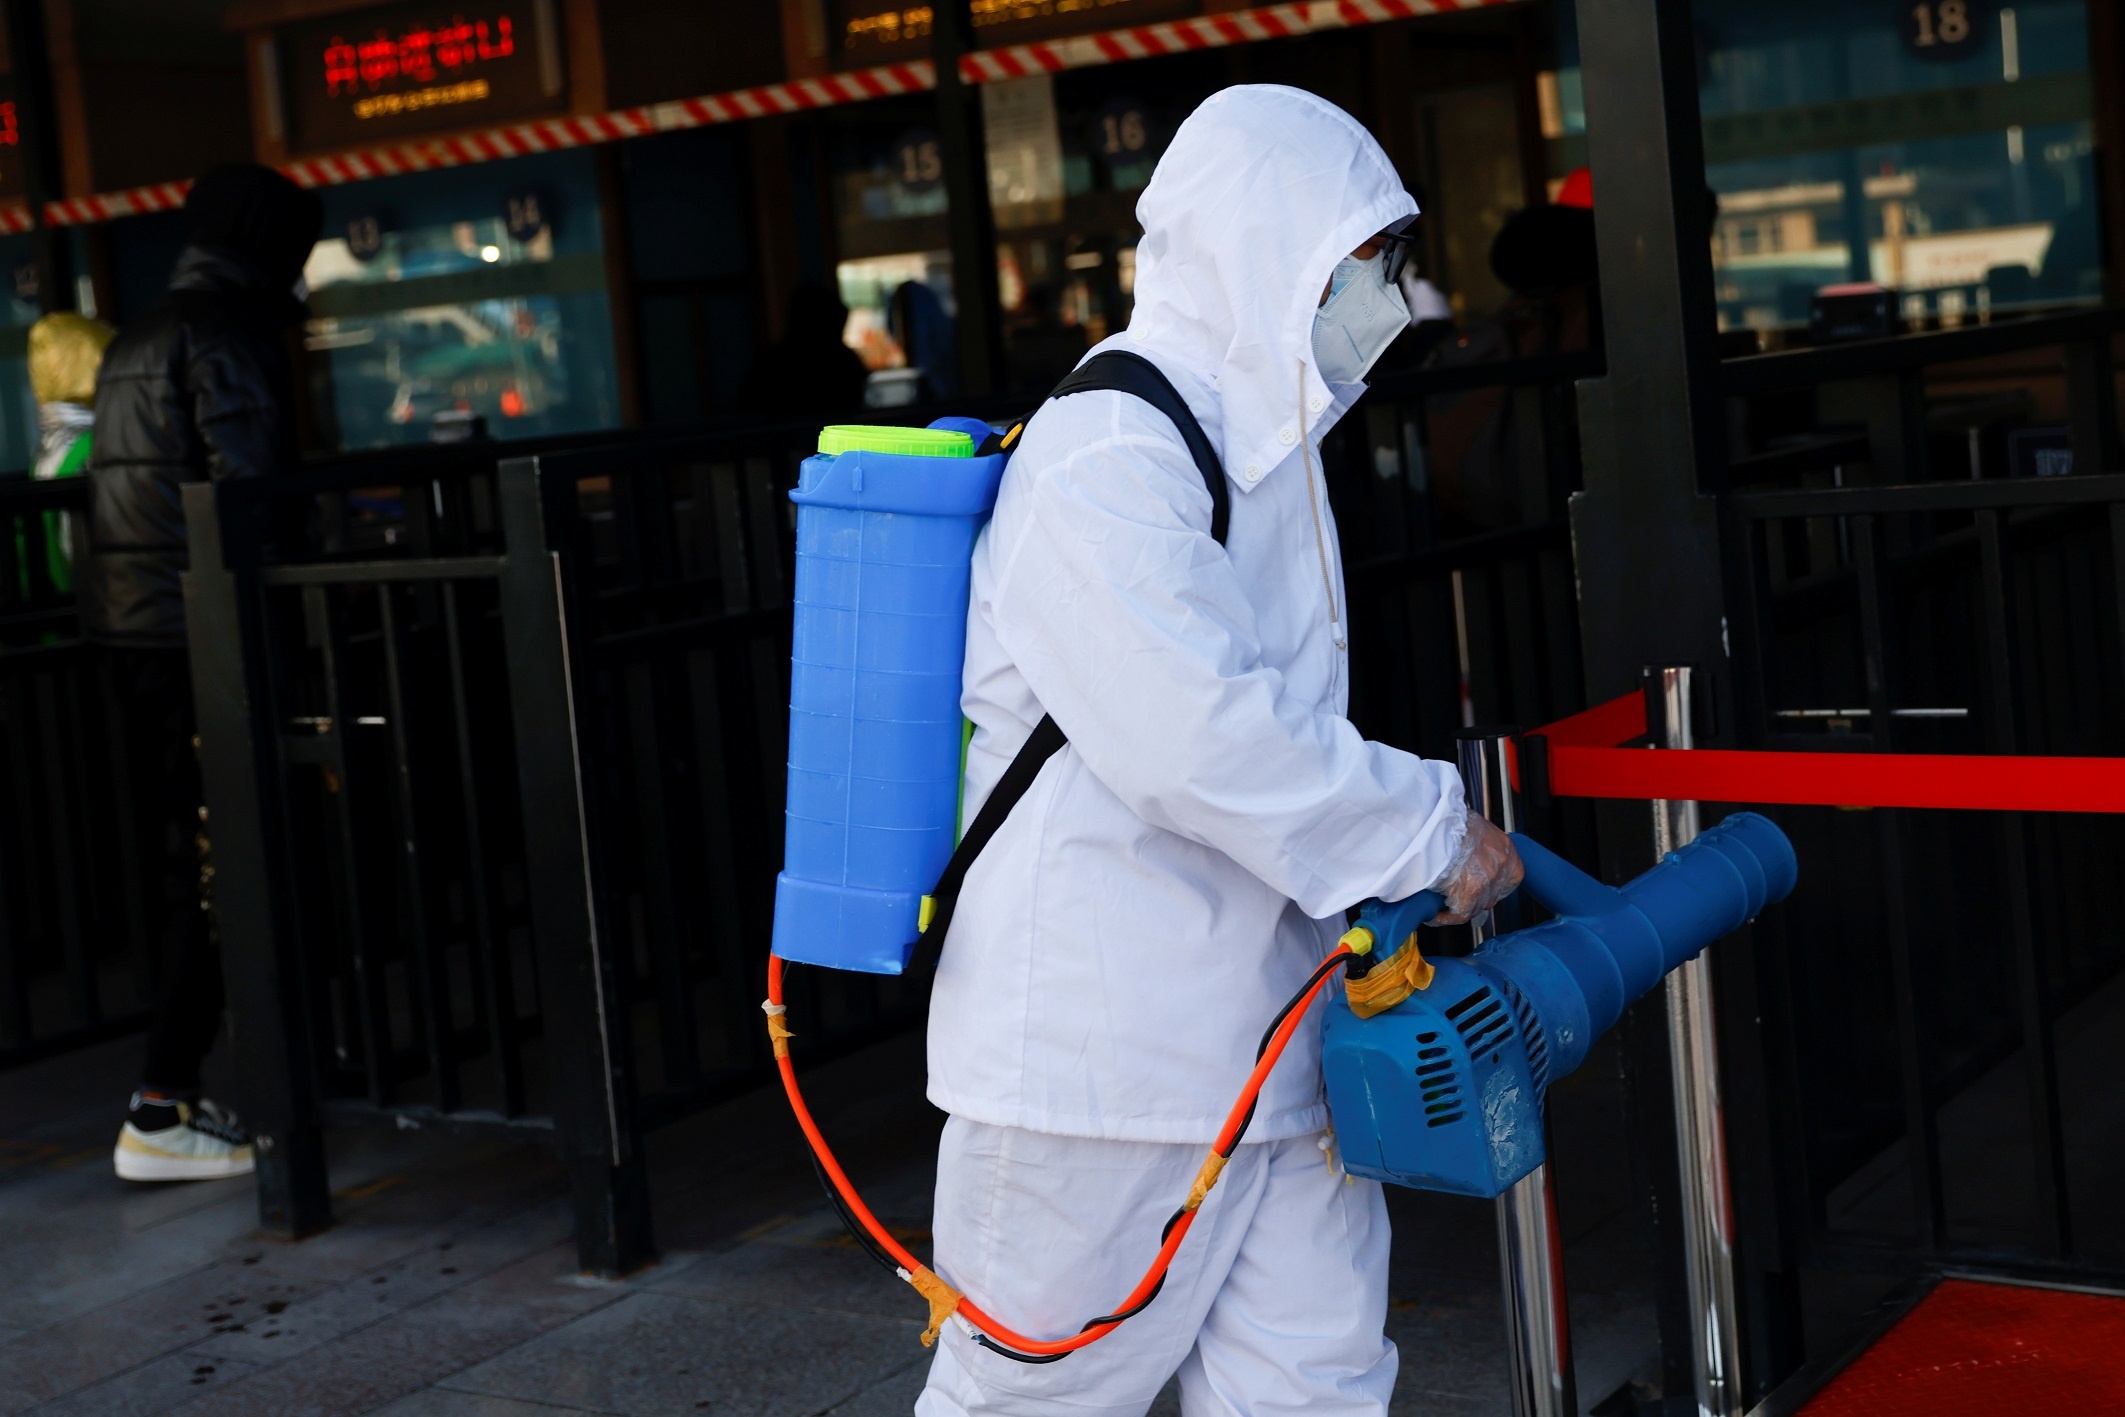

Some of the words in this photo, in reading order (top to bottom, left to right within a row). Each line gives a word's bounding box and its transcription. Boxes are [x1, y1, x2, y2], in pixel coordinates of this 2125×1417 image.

[1911, 0, 1970, 47] 18
[1101, 111, 1147, 155] 16
[902, 140, 943, 184] 15
